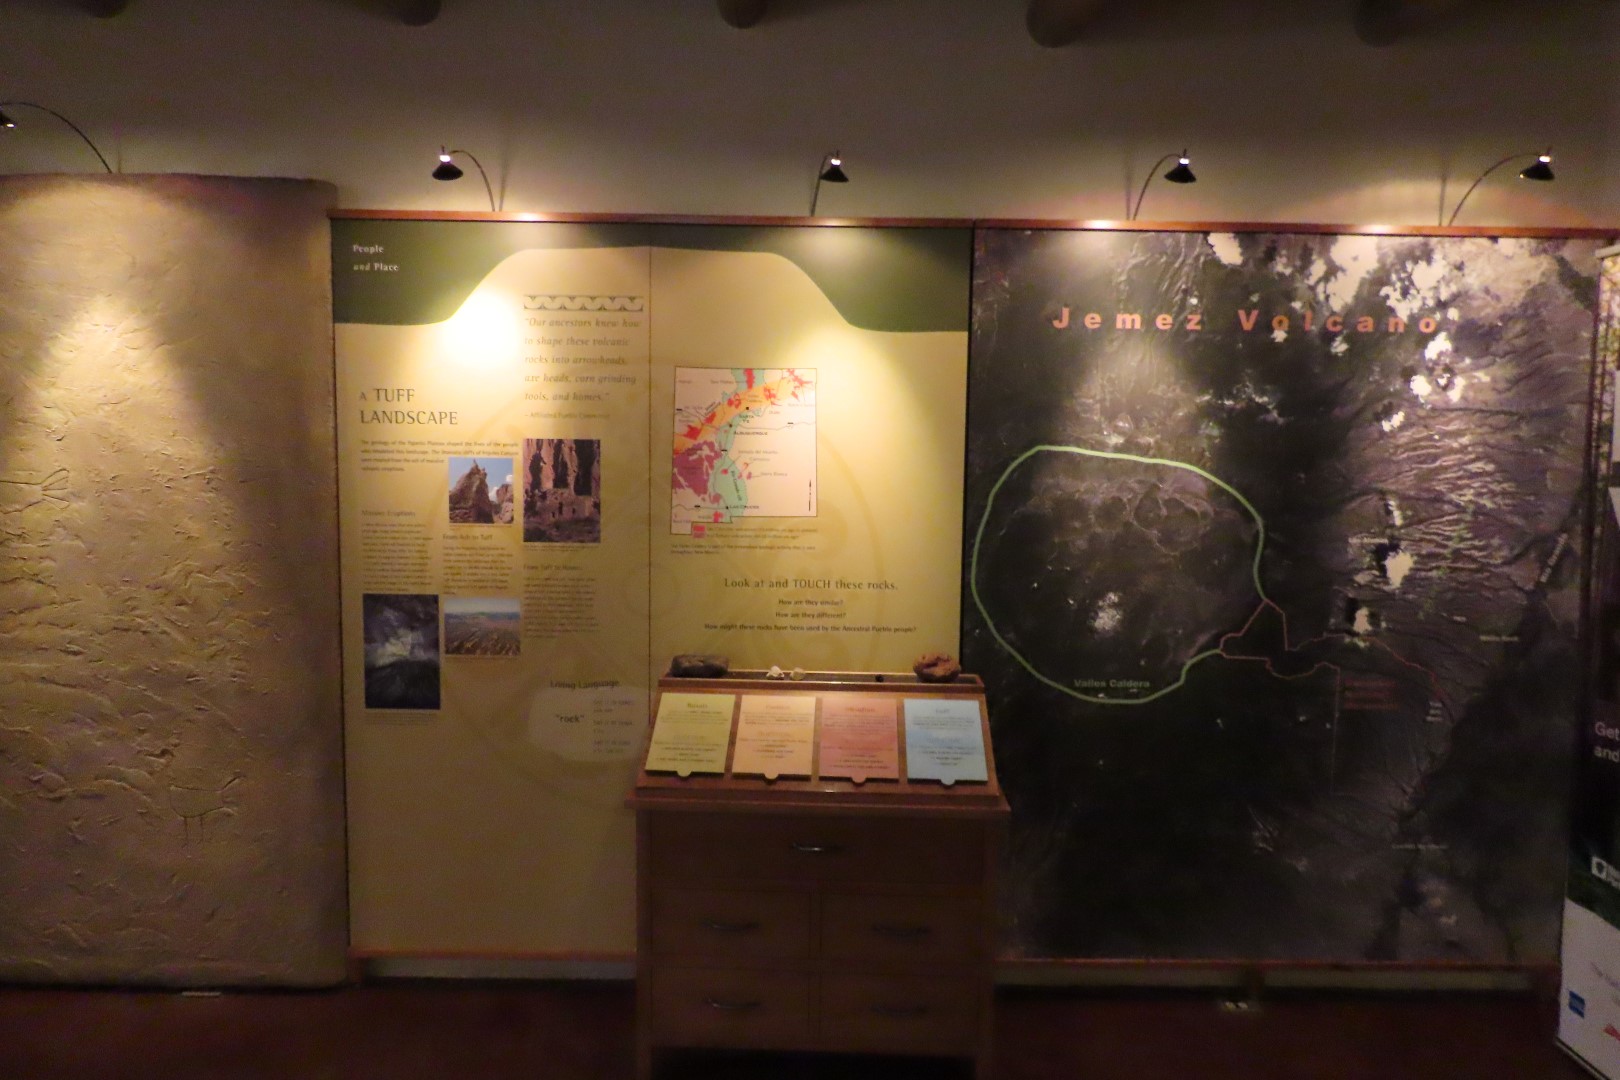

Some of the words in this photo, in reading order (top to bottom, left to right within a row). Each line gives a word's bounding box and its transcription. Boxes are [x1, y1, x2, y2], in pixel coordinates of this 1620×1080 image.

[353, 244, 384, 254] People
[353, 262, 371, 271] and
[374, 262, 399, 271] Place
[549, 318, 592, 328] ancestors
[595, 318, 619, 328] knew
[1052, 306, 1202, 331] Jemez
[1237, 308, 1438, 334] Volcano
[536, 336, 563, 348] shape
[566, 336, 590, 346] these
[592, 337, 630, 346] volcanic
[524, 355, 548, 364] rocks
[552, 355, 570, 364] into
[575, 375, 595, 383] corn
[598, 374, 636, 386] grinding
[373, 388, 415, 402] TUFF
[552, 392, 570, 401] and
[360, 410, 458, 425] LANDSCAPE
[724, 577, 749, 588] Look
[754, 578, 764, 588] at
[768, 578, 788, 588] and
[792, 578, 831, 589] TOUCH
[835, 579, 863, 590] these
[867, 580, 898, 590] rocks.
[805, 599, 818, 607] they
[801, 611, 815, 619] they
[1073, 679, 1106, 688] Valles
[1109, 679, 1151, 688] Caldera
